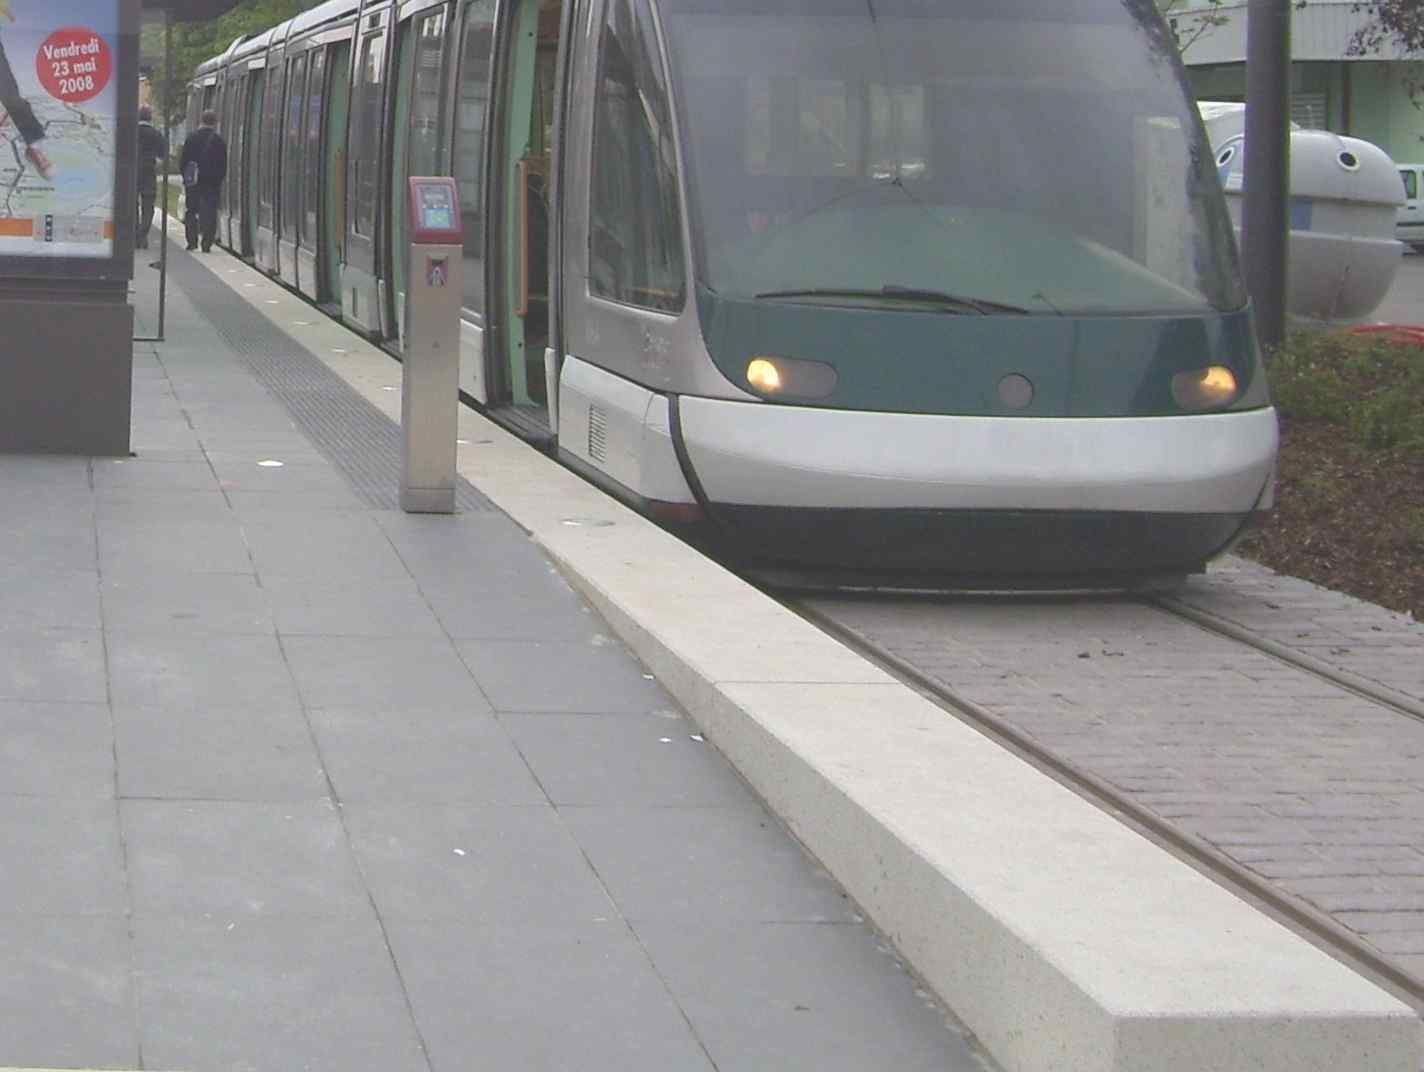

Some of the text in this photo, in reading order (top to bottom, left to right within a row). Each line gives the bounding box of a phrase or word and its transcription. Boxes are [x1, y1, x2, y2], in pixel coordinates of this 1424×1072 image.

[43, 37, 100, 61] Vendredi
[51, 57, 98, 77] 23 mai
[58, 75, 95, 96] 2008
